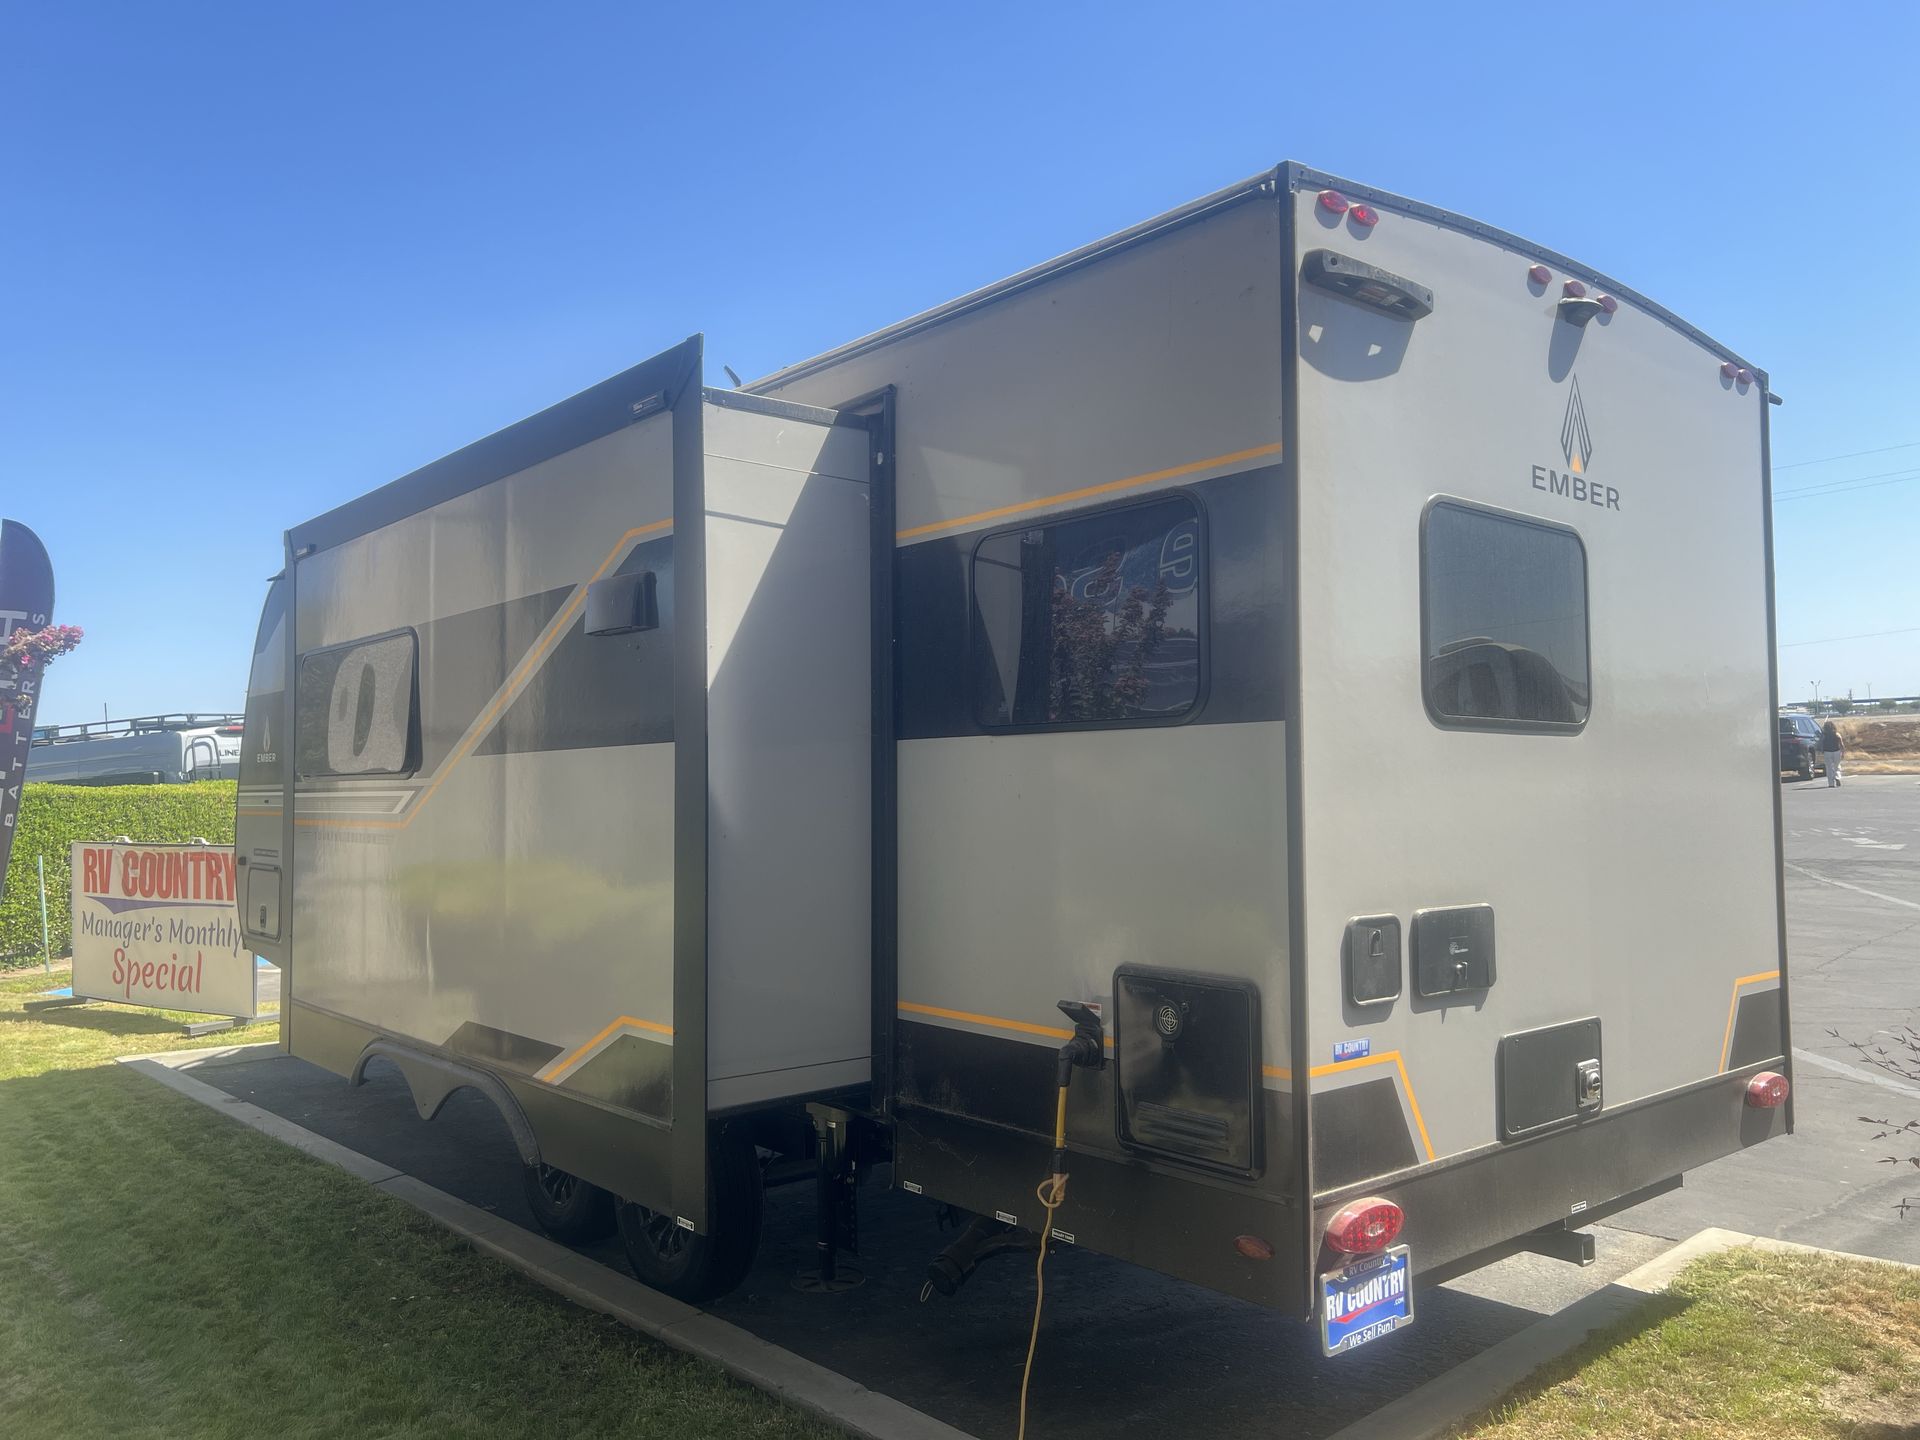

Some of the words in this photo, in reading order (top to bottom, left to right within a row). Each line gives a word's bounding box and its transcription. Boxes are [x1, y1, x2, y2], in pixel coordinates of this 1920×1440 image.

[1532, 464, 1620, 511] EMBER
[4, 613, 45, 827] BATTERS
[256, 753, 276, 763] EMBER
[83, 848, 112, 894] RV
[121, 850, 236, 901] COUNTRY
[81, 910, 163, 949] Manager's
[168, 917, 243, 958] Monthly
[112, 948, 202, 999] Special
[1326, 1292, 1344, 1321] RV
[1347, 1268, 1405, 1312] COUNTRY
[1349, 1333, 1361, 1347] We
[1363, 1325, 1376, 1341] Sell
[1377, 1319, 1393, 1335] Fun!
